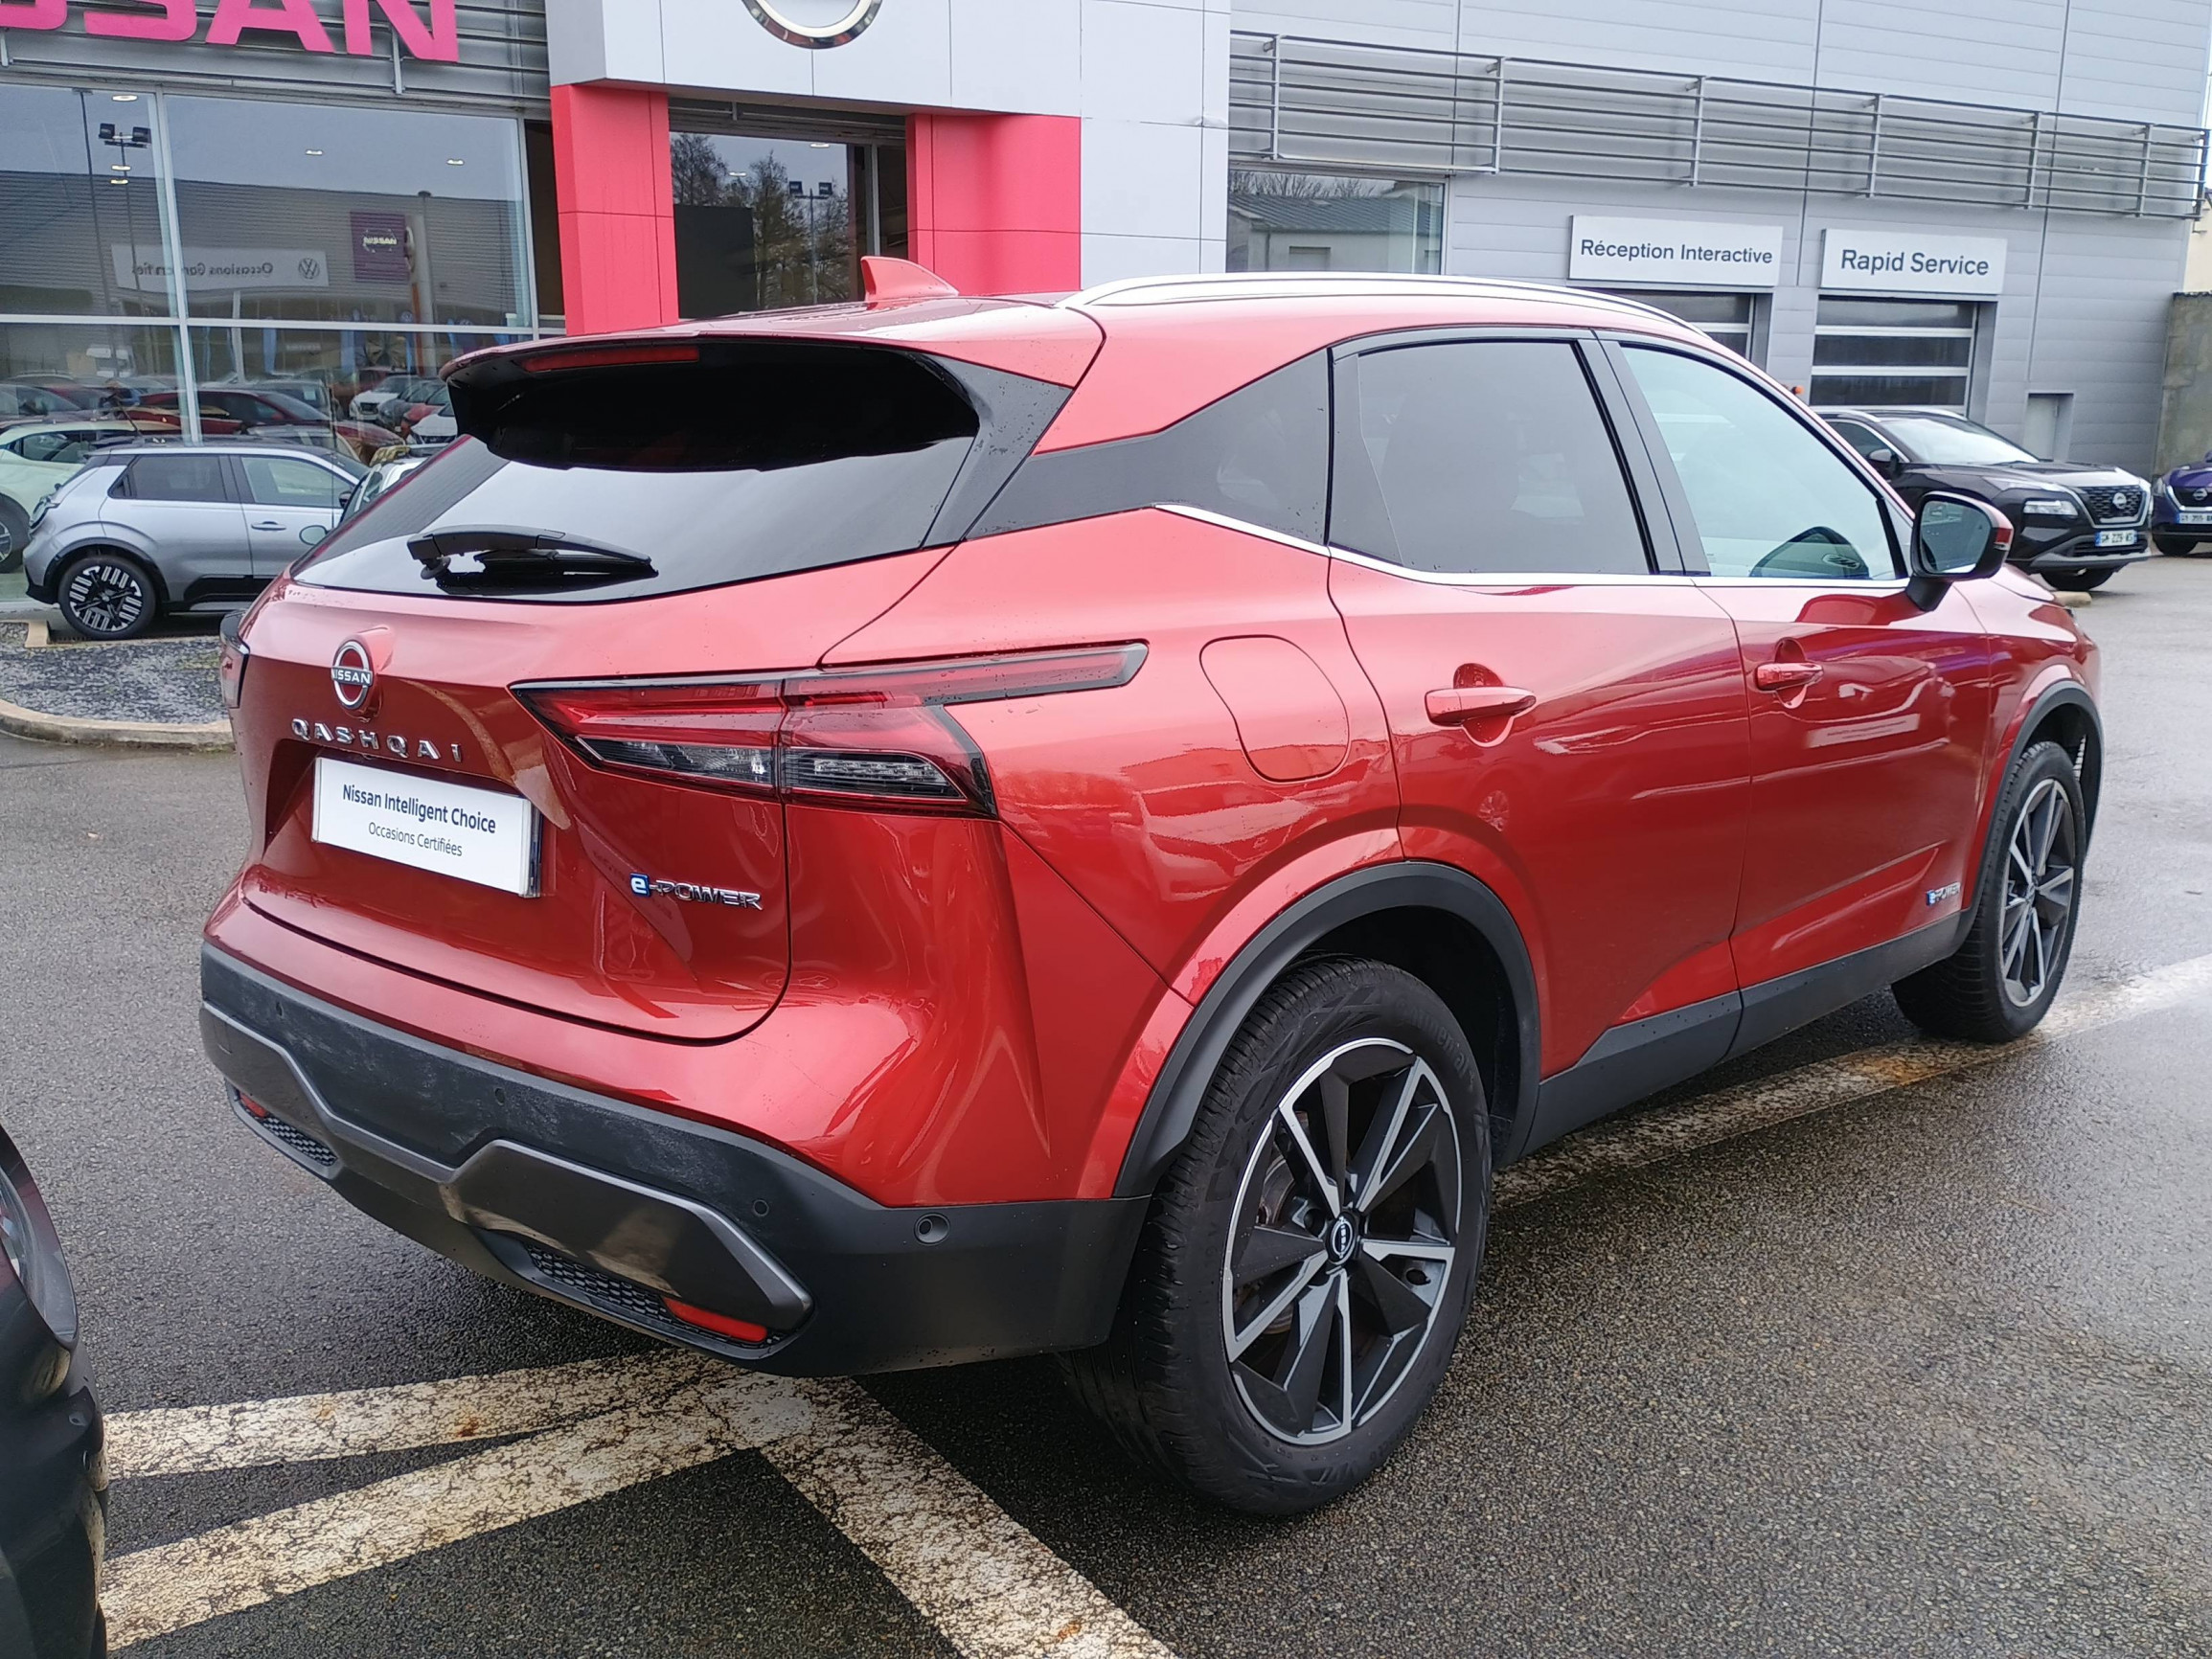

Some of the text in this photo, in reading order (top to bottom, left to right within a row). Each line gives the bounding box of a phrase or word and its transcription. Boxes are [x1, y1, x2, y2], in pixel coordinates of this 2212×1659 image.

[1581, 239, 1773, 264] Réception Interactive
[1840, 249, 1990, 277] Rapid Service
[331, 669, 372, 685] NISSAN
[291, 718, 462, 762] QASHQAI
[343, 784, 496, 834] Nissan Intelligent Choice
[368, 821, 463, 857] Occasions Certifiées
[629, 873, 764, 910] e-POWER
